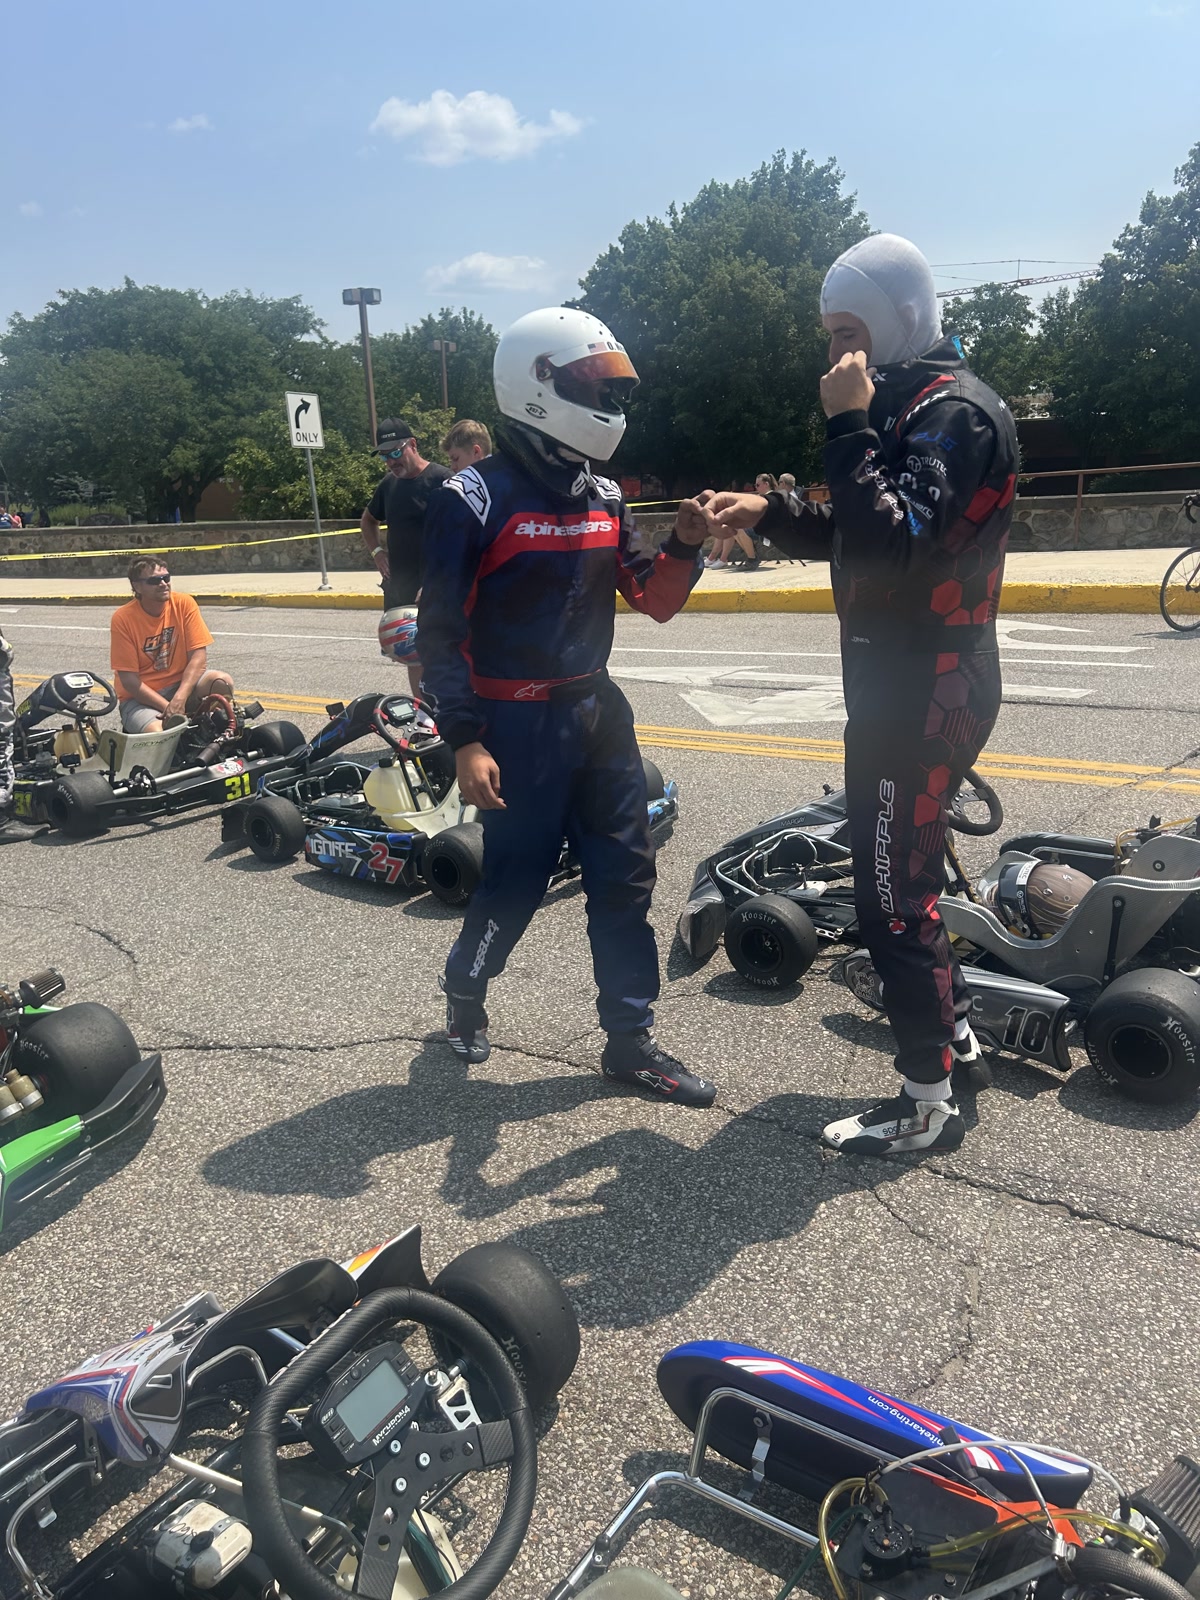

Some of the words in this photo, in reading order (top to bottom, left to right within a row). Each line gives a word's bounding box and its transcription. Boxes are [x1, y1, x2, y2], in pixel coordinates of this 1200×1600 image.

[296, 432, 319, 444] ONLY
[514, 520, 613, 538] alpinestars
[225, 772, 251, 800] 31
[368, 842, 406, 884] 27
[875, 779, 895, 913] WHIPPLE
[741, 911, 778, 925] Hoosier
[1003, 1005, 1051, 1055] 10
[1160, 1016, 1196, 1064] Hoosier
